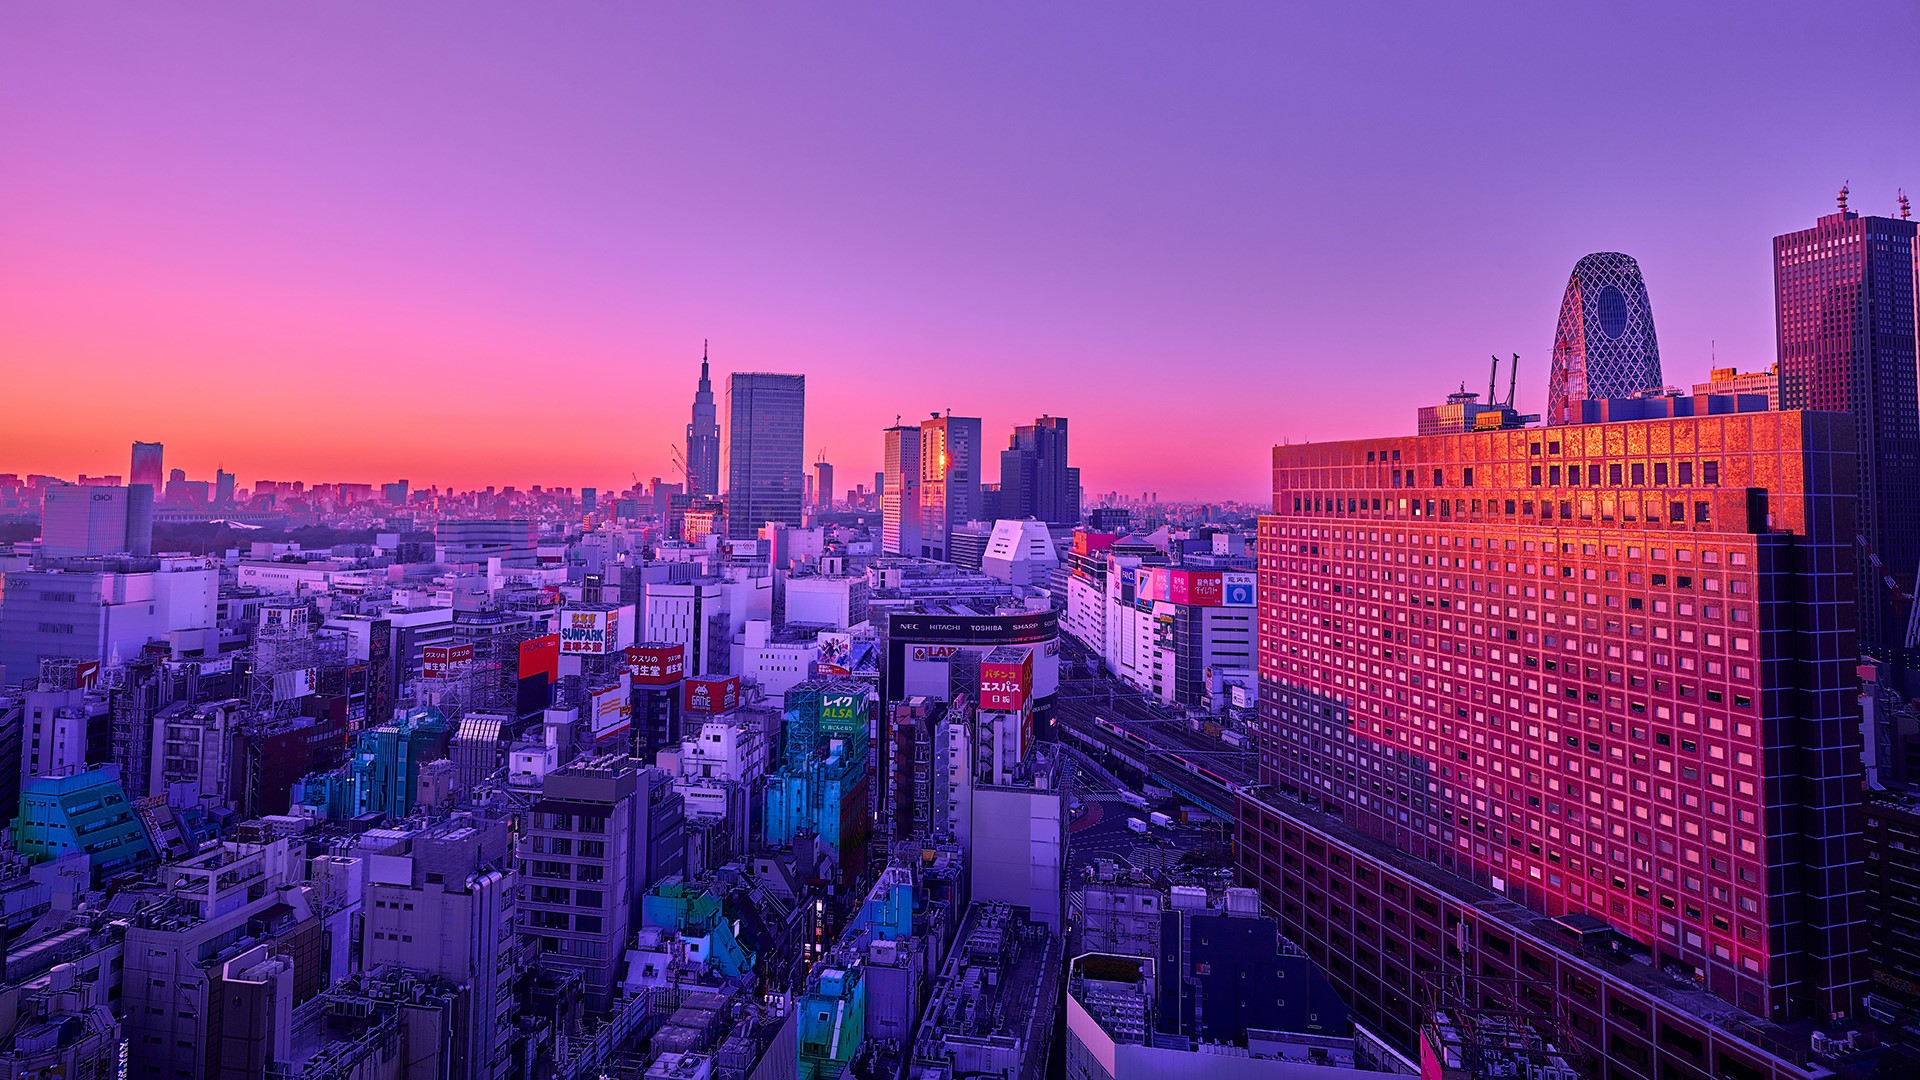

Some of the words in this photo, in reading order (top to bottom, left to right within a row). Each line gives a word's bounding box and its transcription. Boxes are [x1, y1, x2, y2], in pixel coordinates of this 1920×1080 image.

[971, 624, 1002, 632] TOSHIBA
[1012, 623, 1038, 631] SHARP
[562, 628, 604, 641] SUNPARK
[928, 646, 960, 657] LAB
[631, 655, 658, 663] クスリの
[985, 669, 1016, 679] パチンコ
[981, 680, 1020, 692] エスパス
[823, 695, 853, 707] レイク
[822, 707, 853, 719] ALSA
